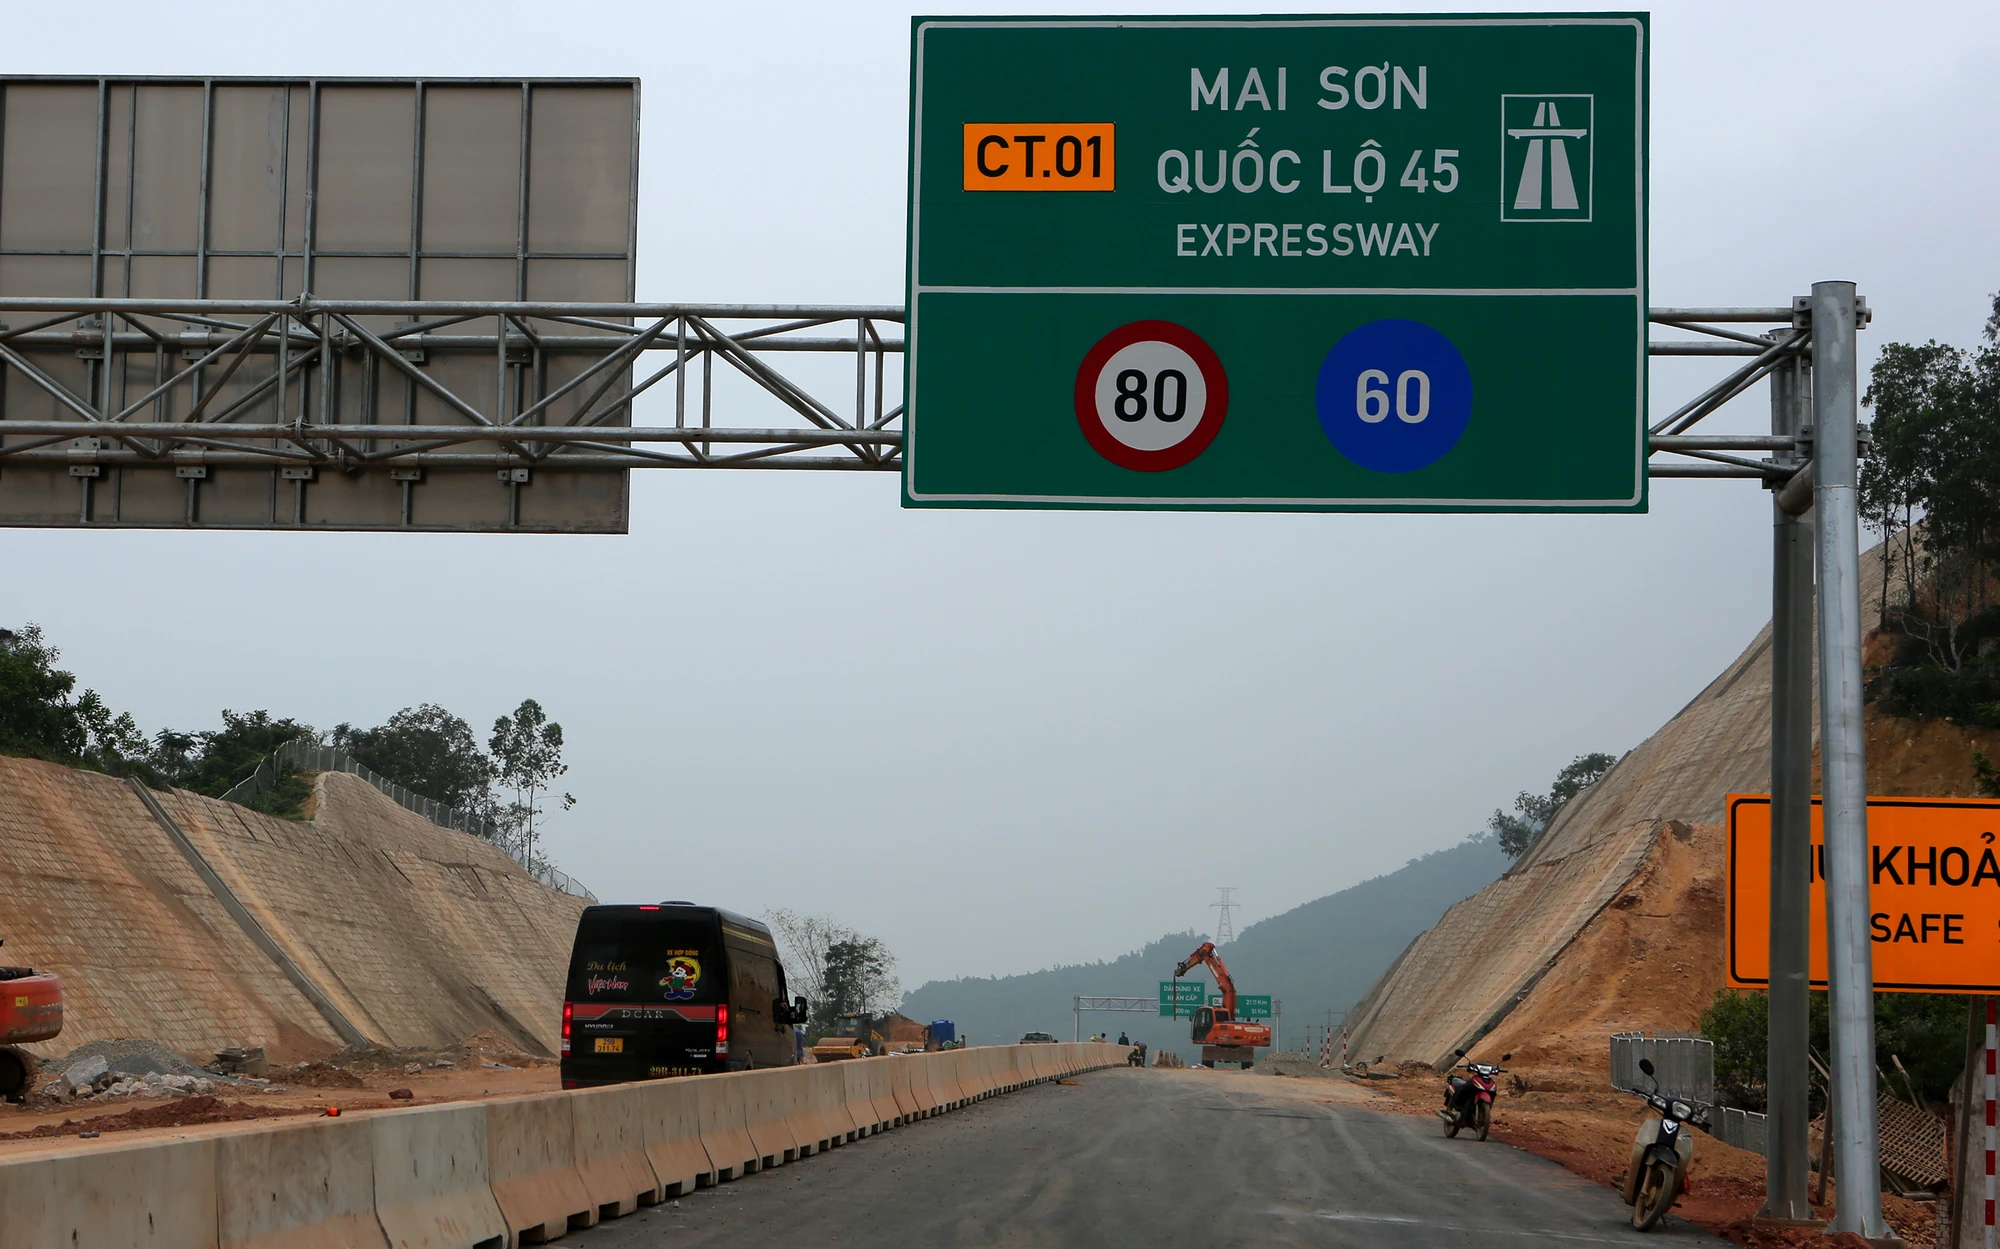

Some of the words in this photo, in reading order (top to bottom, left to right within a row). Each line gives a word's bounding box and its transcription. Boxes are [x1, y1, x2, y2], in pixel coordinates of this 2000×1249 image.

[1190, 67, 1287, 111] MAI
[1318, 61, 1427, 110] SƠN
[977, 135, 1103, 178] CT.01
[1157, 128, 1301, 194] QUỐC
[1323, 140, 1386, 203] LỘ
[1400, 149, 1459, 193] 45
[1177, 223, 1440, 257] EXPRESSWAY
[1114, 369, 1188, 424] 80
[1356, 369, 1430, 424] 60
[1870, 912, 1964, 945] SAFE
[587, 961, 604, 971] Du
[607, 961, 627, 972] lịch
[622, 1010, 663, 1019] DCAR
